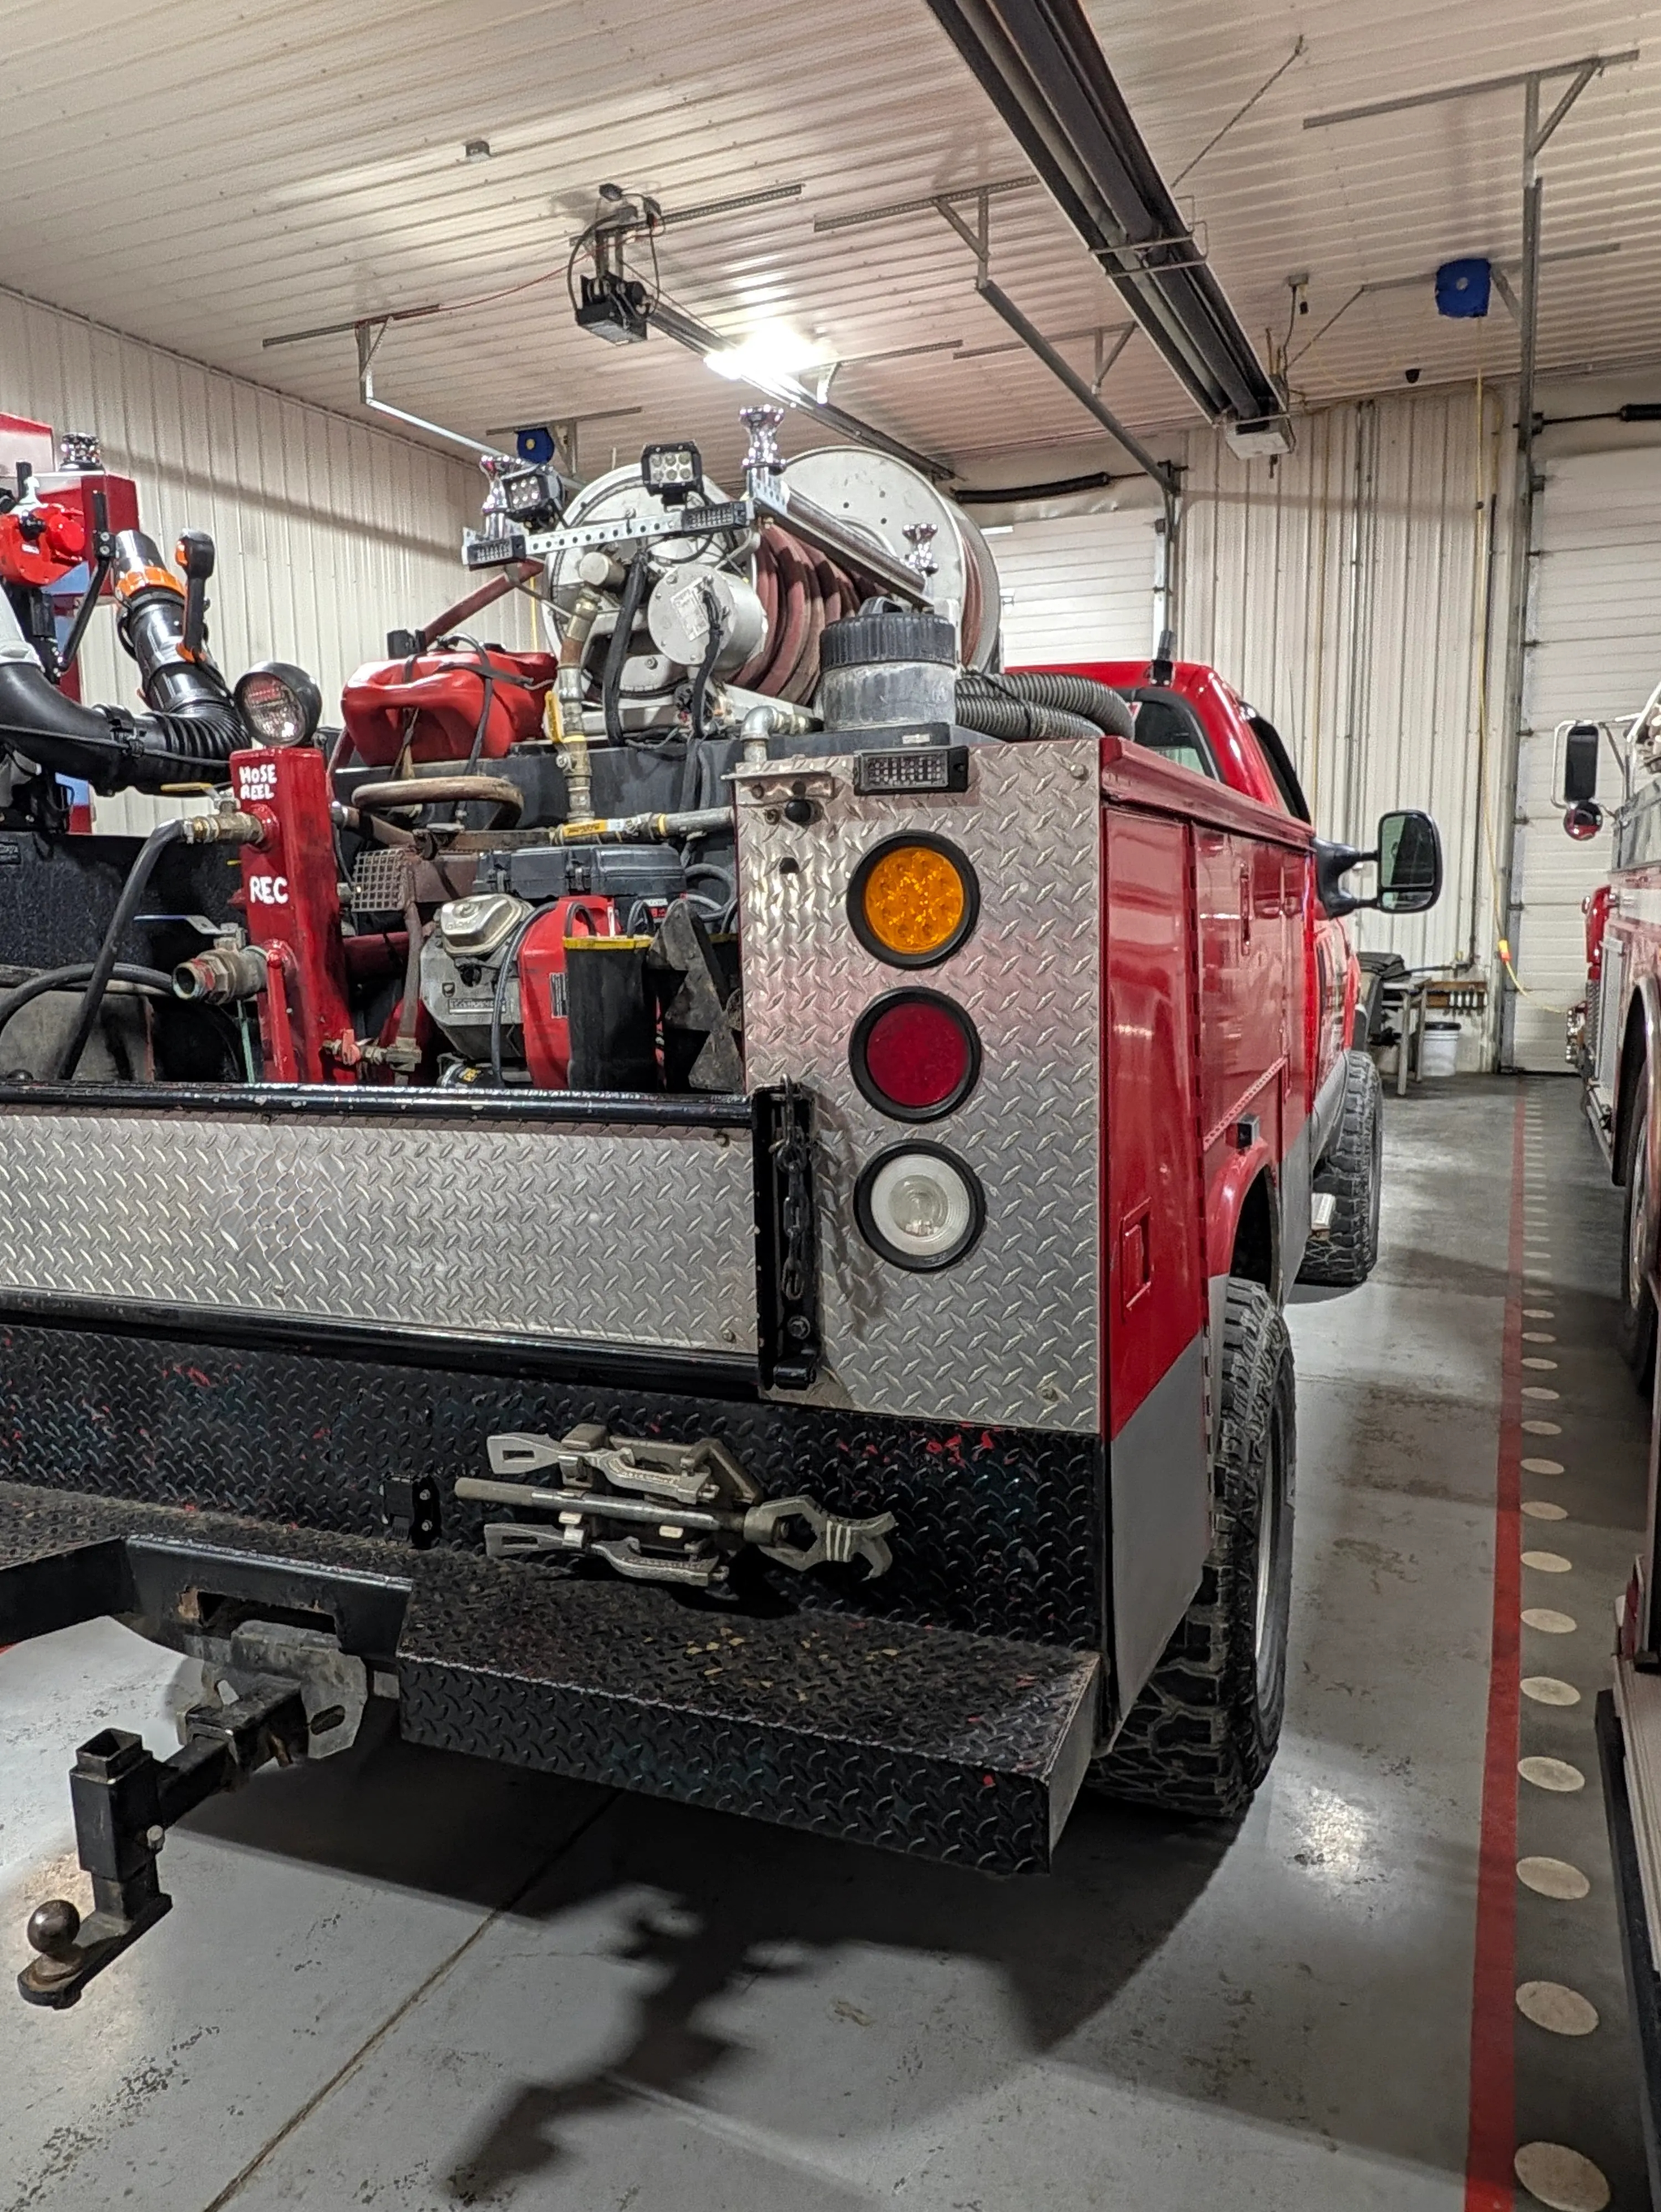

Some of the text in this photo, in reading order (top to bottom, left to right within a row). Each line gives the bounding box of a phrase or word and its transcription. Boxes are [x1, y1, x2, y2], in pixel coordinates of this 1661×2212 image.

[238, 763, 277, 784] HOSE
[240, 784, 275, 801] REEL
[250, 875, 289, 904] REC
